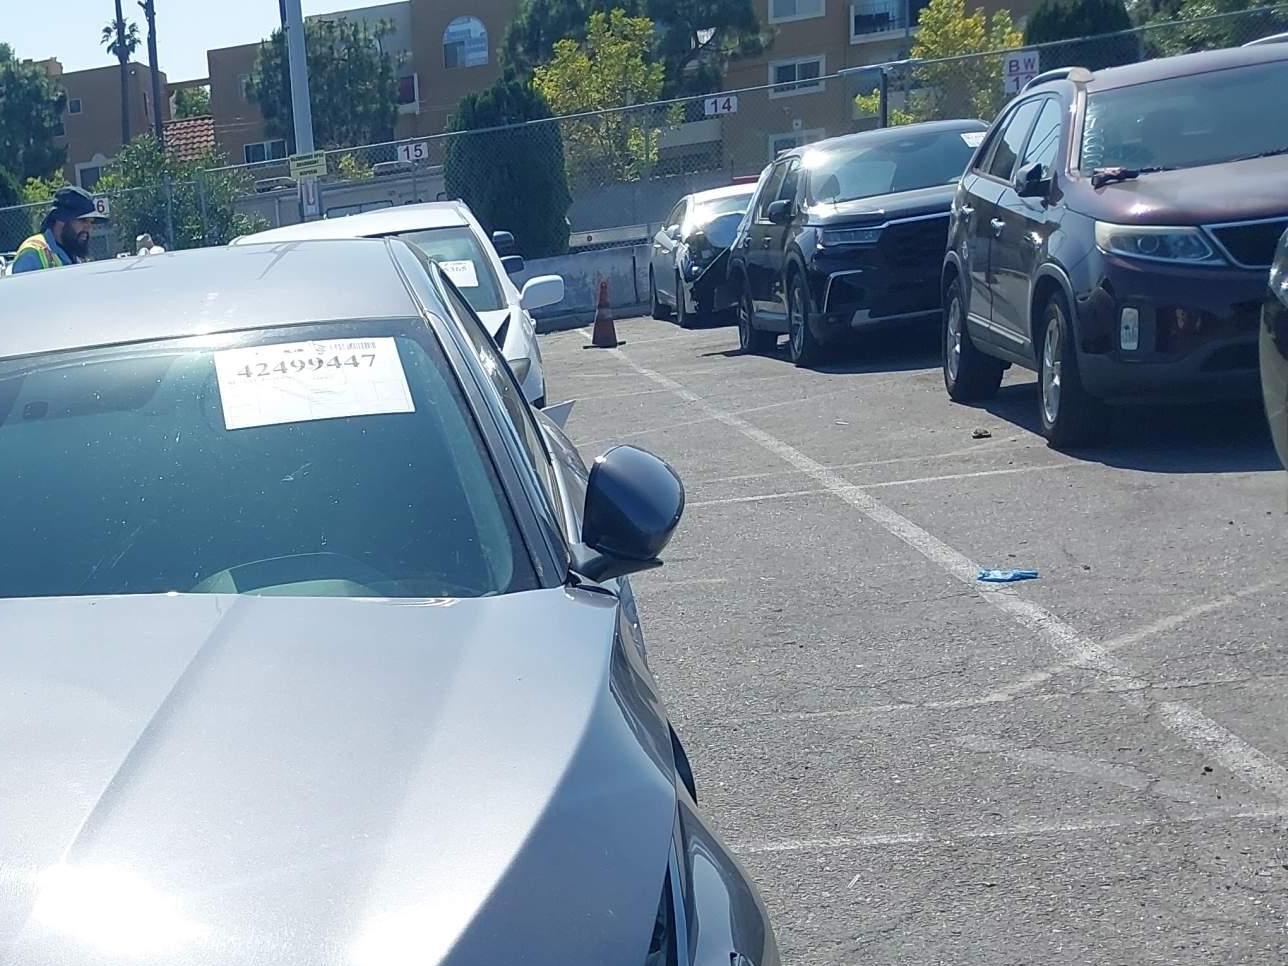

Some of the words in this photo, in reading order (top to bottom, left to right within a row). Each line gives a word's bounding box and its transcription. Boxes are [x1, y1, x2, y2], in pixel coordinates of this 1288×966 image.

[711, 97, 732, 113] 14
[402, 144, 424, 160] 15
[96, 199, 106, 214] 6
[236, 353, 376, 378] 42499447
